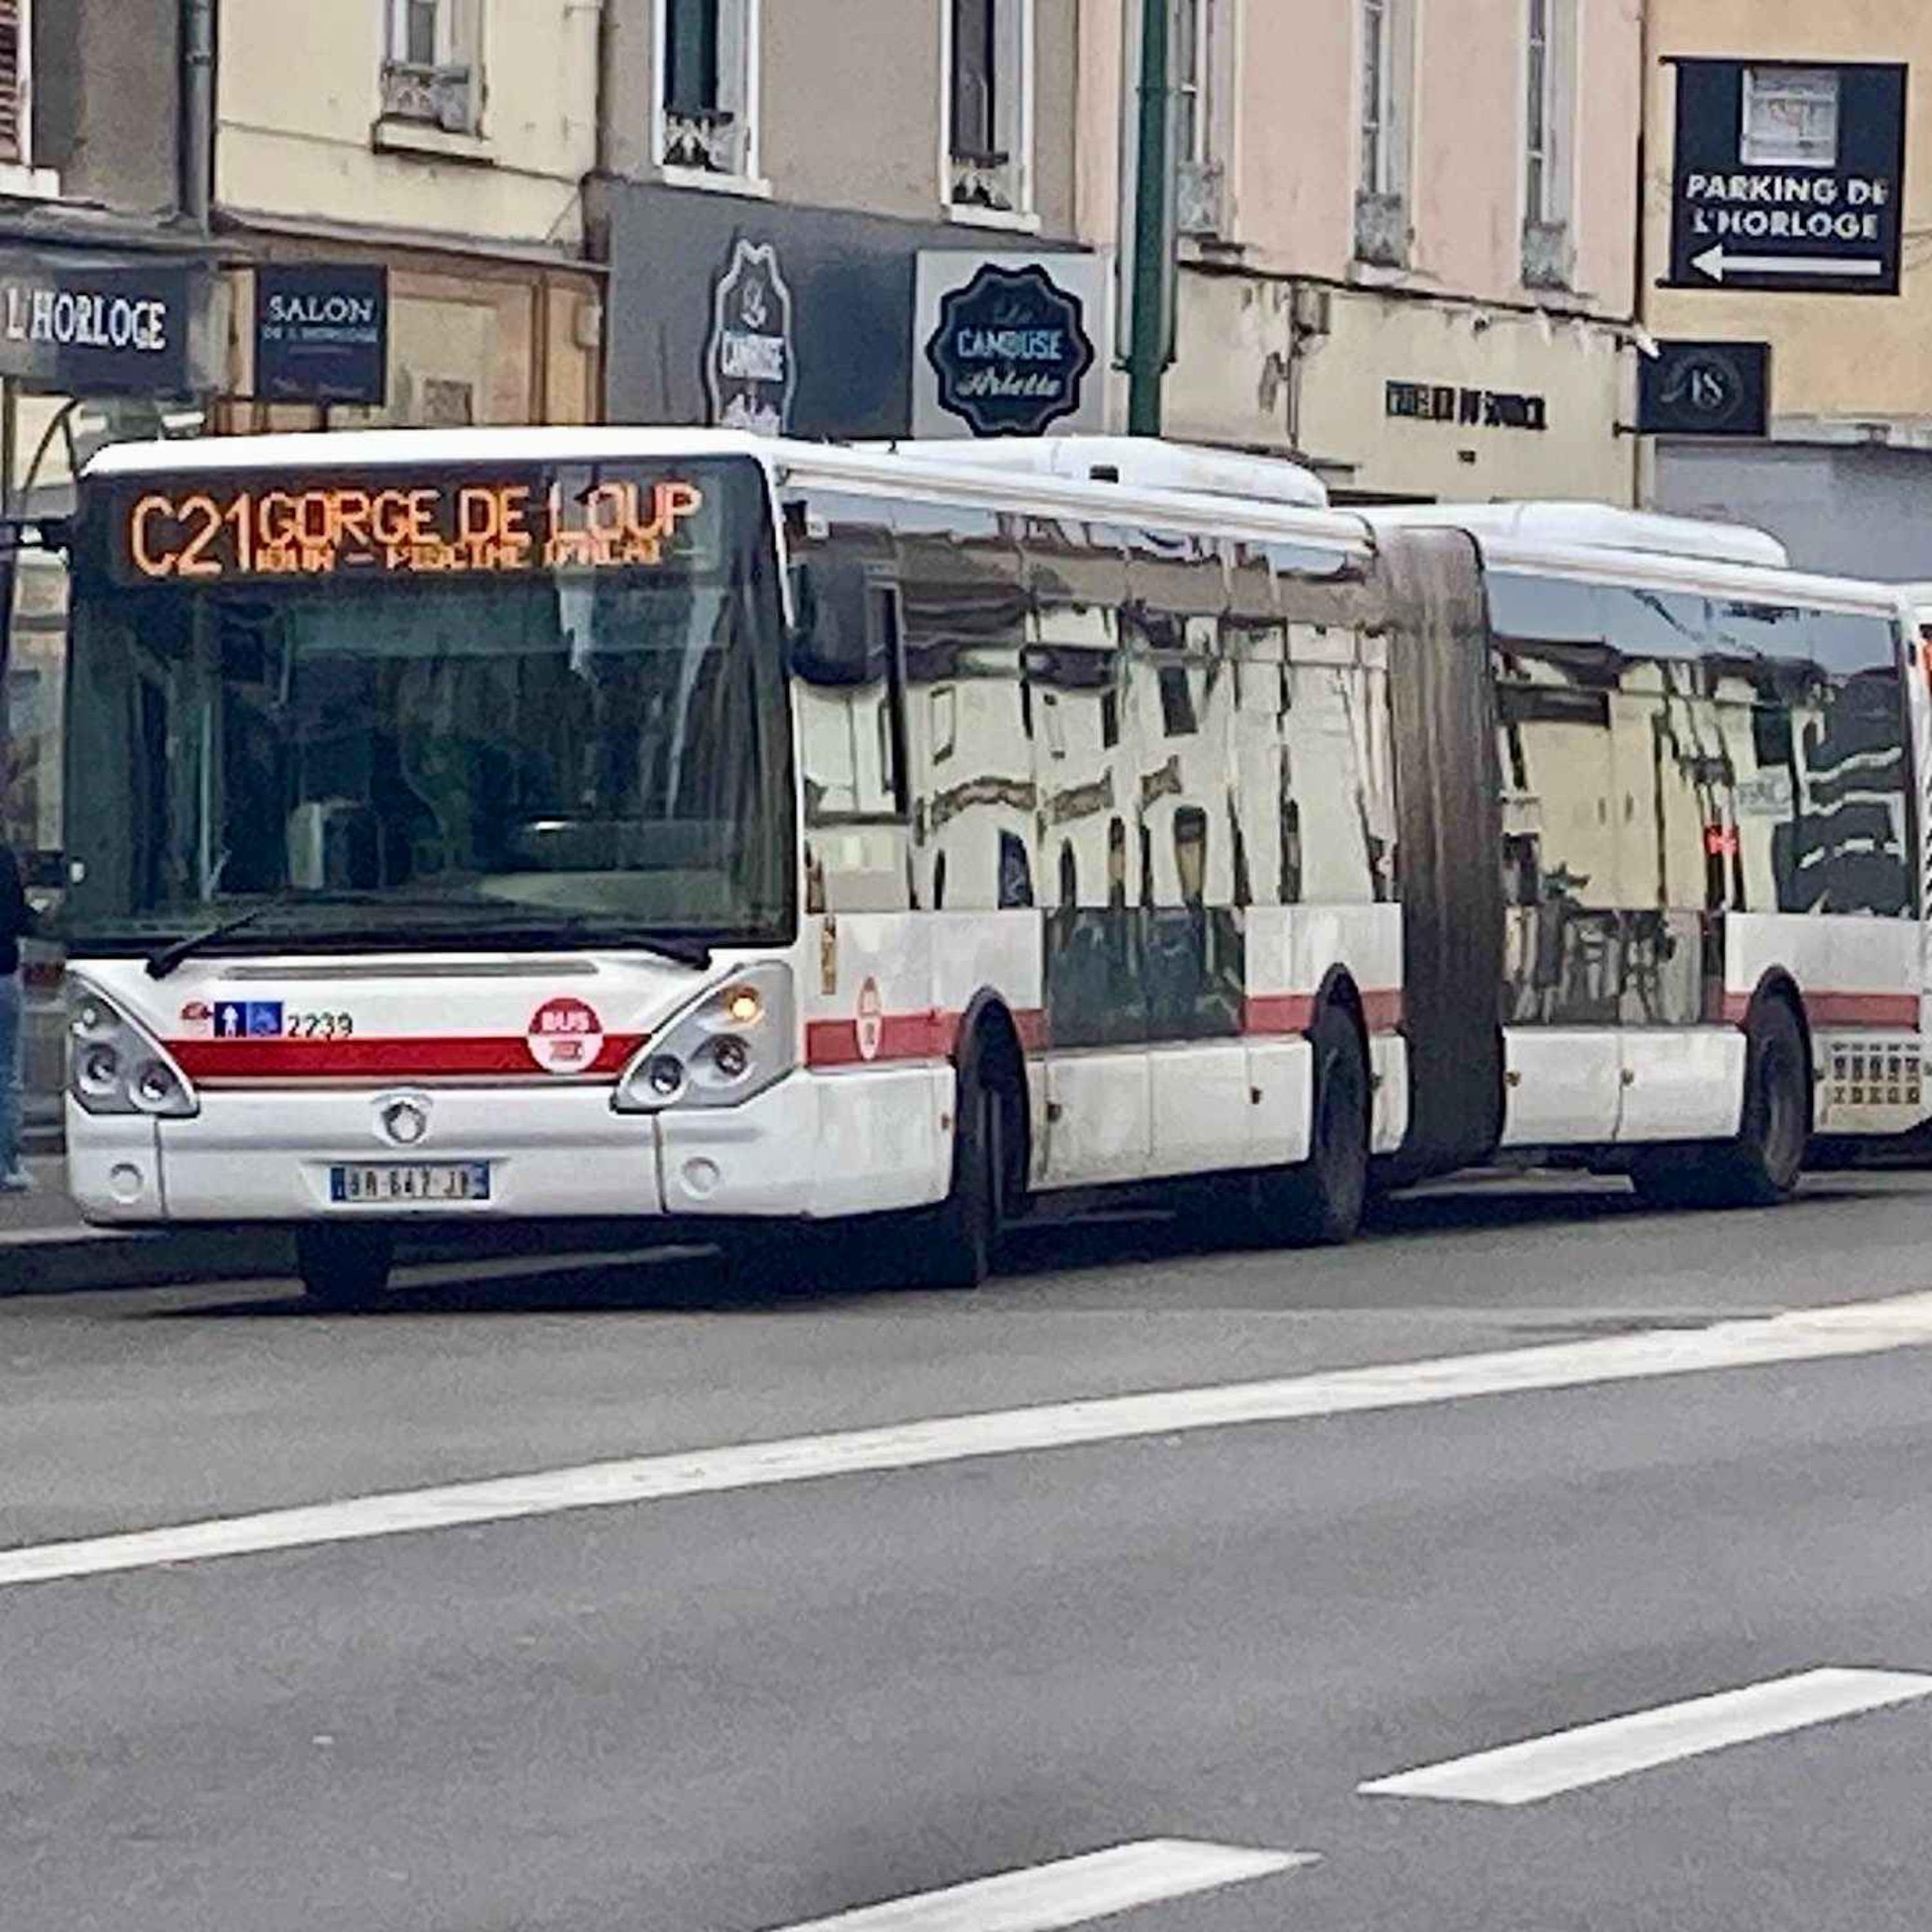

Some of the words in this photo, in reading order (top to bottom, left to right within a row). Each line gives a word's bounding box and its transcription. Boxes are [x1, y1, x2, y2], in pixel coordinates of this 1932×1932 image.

[1686, 175, 1838, 205] PARKING
[1693, 207, 1878, 240] L'HORLOGE
[269, 295, 375, 322] SALON
[259, 487, 442, 548] GORGE
[460, 485, 531, 548] DE
[547, 480, 703, 542] LOUP
[131, 493, 252, 577] C21
[542, 1011, 590, 1031] BUS
